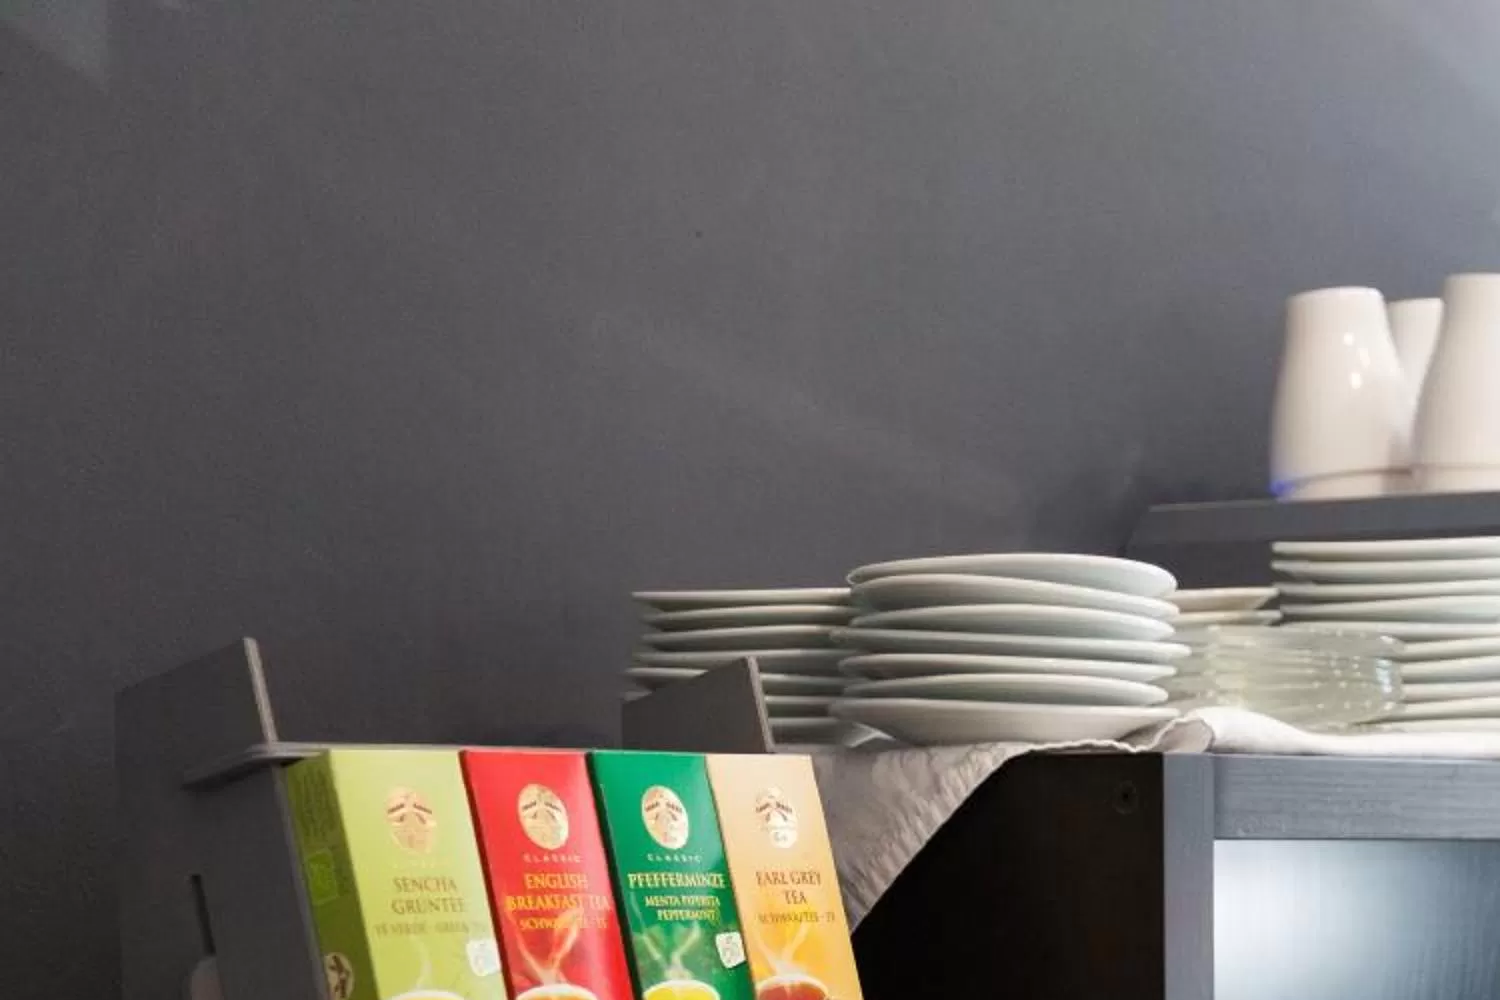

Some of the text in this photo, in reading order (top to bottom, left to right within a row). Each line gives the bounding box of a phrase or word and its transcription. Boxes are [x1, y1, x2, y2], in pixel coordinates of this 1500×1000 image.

[392, 876, 458, 893] SENCHA
[524, 872, 589, 889] ENGLISH
[626, 871, 726, 889] PFEFFERMINZE
[755, 869, 823, 886] EARL GREY
[504, 894, 583, 911] BREAKFAST
[783, 889, 809, 905] TEA
